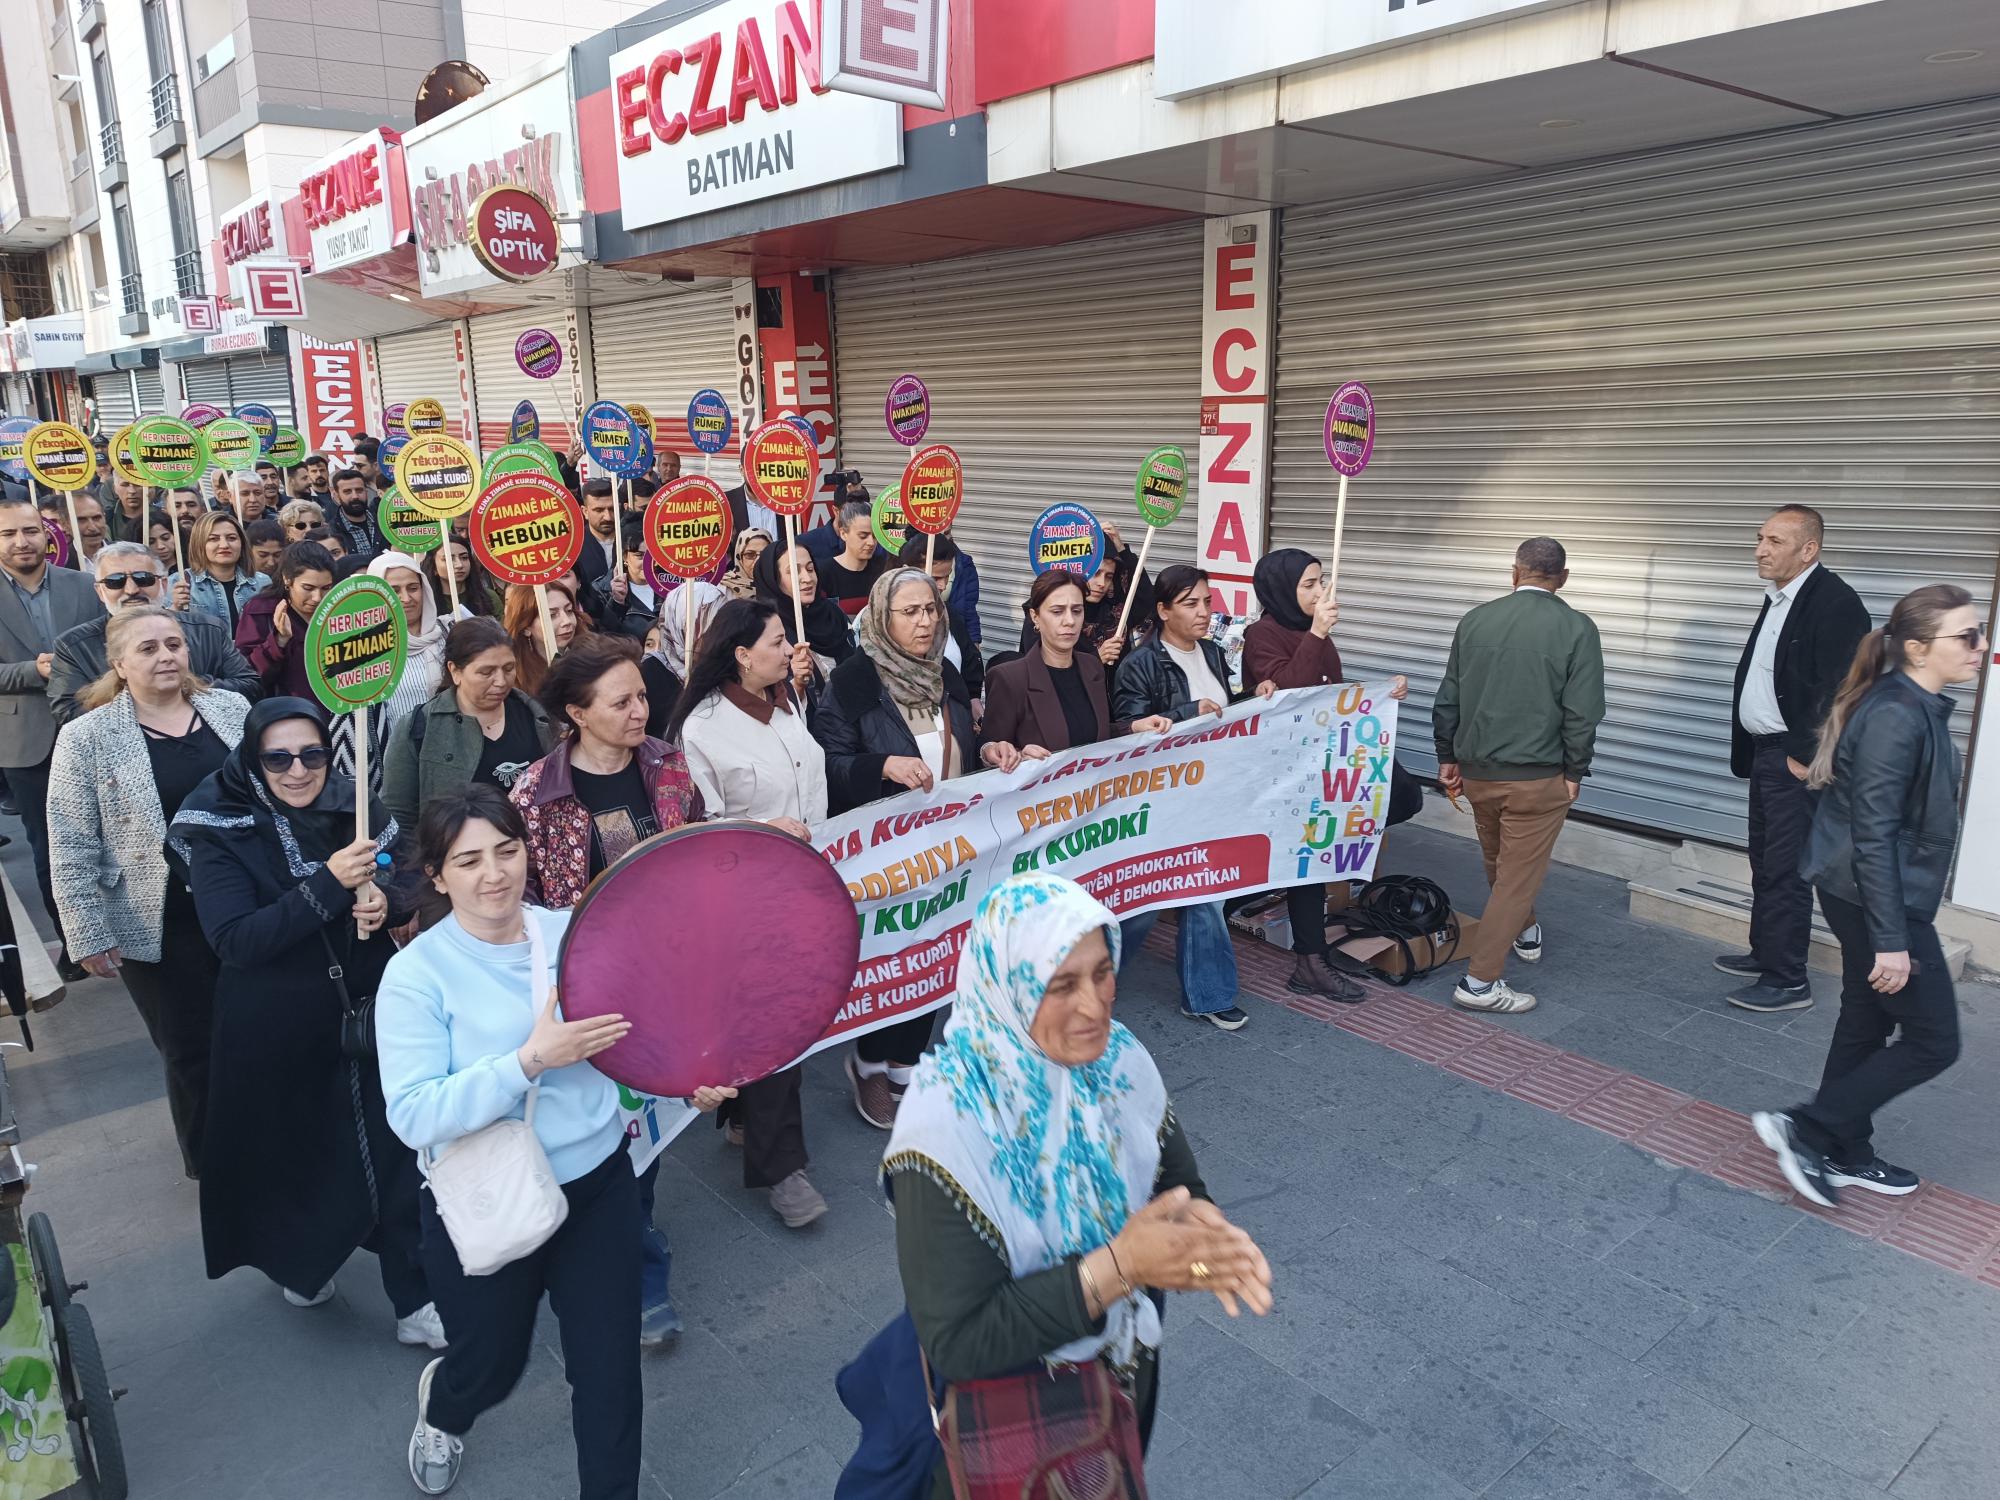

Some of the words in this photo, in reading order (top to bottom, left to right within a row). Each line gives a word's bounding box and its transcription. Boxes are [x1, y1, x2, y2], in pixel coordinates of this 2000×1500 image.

[616, 0, 832, 158] ECZAN
[687, 129, 795, 196] BATMAN
[299, 143, 383, 231] ECZANE
[494, 206, 537, 236] ŞİFA
[221, 200, 275, 266] ECZANE
[326, 232, 347, 260] YUSUF
[347, 224, 370, 254] YAKUT
[489, 237, 548, 263] OPTİK
[257, 275, 293, 309] E
[190, 308, 206, 326] E
[311, 355, 358, 474] ECZAN
[695, 416, 726, 432] RÛMETA
[37, 439, 80, 449] TÊKOŞÎNA
[142, 433, 158, 443] HER
[160, 433, 190, 444] NETEW
[211, 441, 219, 449] BI
[220, 438, 251, 450] ZIMANÊ
[593, 431, 631, 446] RÛMETA
[35, 451, 65, 464] ZIMANÊ
[66, 450, 88, 463] KURDÎ
[141, 447, 151, 458] BI
[153, 445, 196, 460] ZIMANÊ
[428, 444, 445, 454] EM
[601, 449, 614, 459] ME
[613, 450, 625, 461] YE
[761, 441, 794, 455] ZIMANÊ
[795, 445, 805, 457] ME
[148, 463, 168, 472] XWE
[169, 463, 192, 472] HEYE
[411, 454, 464, 469] TÊKOŞÎNA
[1152, 460, 1166, 474] HER
[408, 471, 443, 487] ZIMANÊ
[443, 470, 471, 484] KURDÎ
[758, 461, 809, 481] HEBÛNA
[917, 464, 946, 480] ZIMANÊ
[418, 490, 444, 500] BILIND
[445, 490, 466, 499] BIKIN
[477, 494, 493, 515] CEJNA
[489, 478, 514, 497] ZIMANÊ
[515, 477, 538, 485] KURDÎ
[538, 479, 557, 492] PÎROZ
[771, 485, 789, 498] ME
[790, 486, 803, 498] YE
[911, 484, 956, 500] HEBÛNA
[1145, 476, 1154, 489] BI
[1155, 479, 1184, 498] ZIMANÊ
[489, 497, 539, 521] ZIMANÊ
[540, 497, 559, 513] ME
[666, 498, 703, 514] ZIMANÊ
[703, 500, 719, 512] ME
[1146, 494, 1162, 508] XWE
[391, 511, 401, 521] BI
[883, 513, 893, 524] BI
[920, 506, 937, 519] ME
[938, 506, 947, 518] YE
[398, 527, 415, 537] XWE
[416, 526, 437, 536] HEYE
[488, 519, 570, 549] HEBÛNA
[660, 518, 721, 540] HEBÛNA
[1043, 521, 1076, 539] ZIMANÊ
[1076, 524, 1090, 537] ME
[511, 551, 538, 568] ME
[540, 547, 560, 564] YE
[674, 547, 694, 560] ME
[694, 544, 709, 558] YE
[1042, 540, 1093, 557] RÛMETA
[1069, 561, 1083, 574] YE
[330, 581, 357, 605] ZIMANÊ
[328, 614, 353, 635] HER
[354, 605, 388, 628] NETEW
[324, 645, 340, 666] BI
[344, 626, 395, 661] ZIMANÊ
[336, 668, 363, 690] XWE
[364, 660, 391, 682] HEYE
[1358, 699, 1372, 716] Q
[1293, 715, 1303, 723] W
[1354, 715, 1381, 748] Q
[1367, 756, 1390, 783] X
[1321, 768, 1363, 803] W
[1358, 786, 1372, 802] X
[1017, 759, 1206, 835] PERWERDEYO
[871, 794, 984, 848] KURDÎ
[1359, 819, 1376, 837] Q
[1012, 846, 1043, 877] BI
[1045, 802, 1152, 866] KURDKÎ
[1116, 846, 1209, 885] DEMOKRATÎK
[1320, 852, 1332, 865] Q
[1334, 842, 1375, 874] W
[848, 835, 978, 903] RDEHIYA
[1123, 866, 1240, 904] DEMOKRATÎKAN
[873, 869, 972, 937] KURDÎ
[848, 957, 903, 993] MANÊ
[906, 933, 955, 972] KURDÎ
[832, 993, 874, 1025] ANÊ
[877, 967, 945, 1009] KURDKÎ
